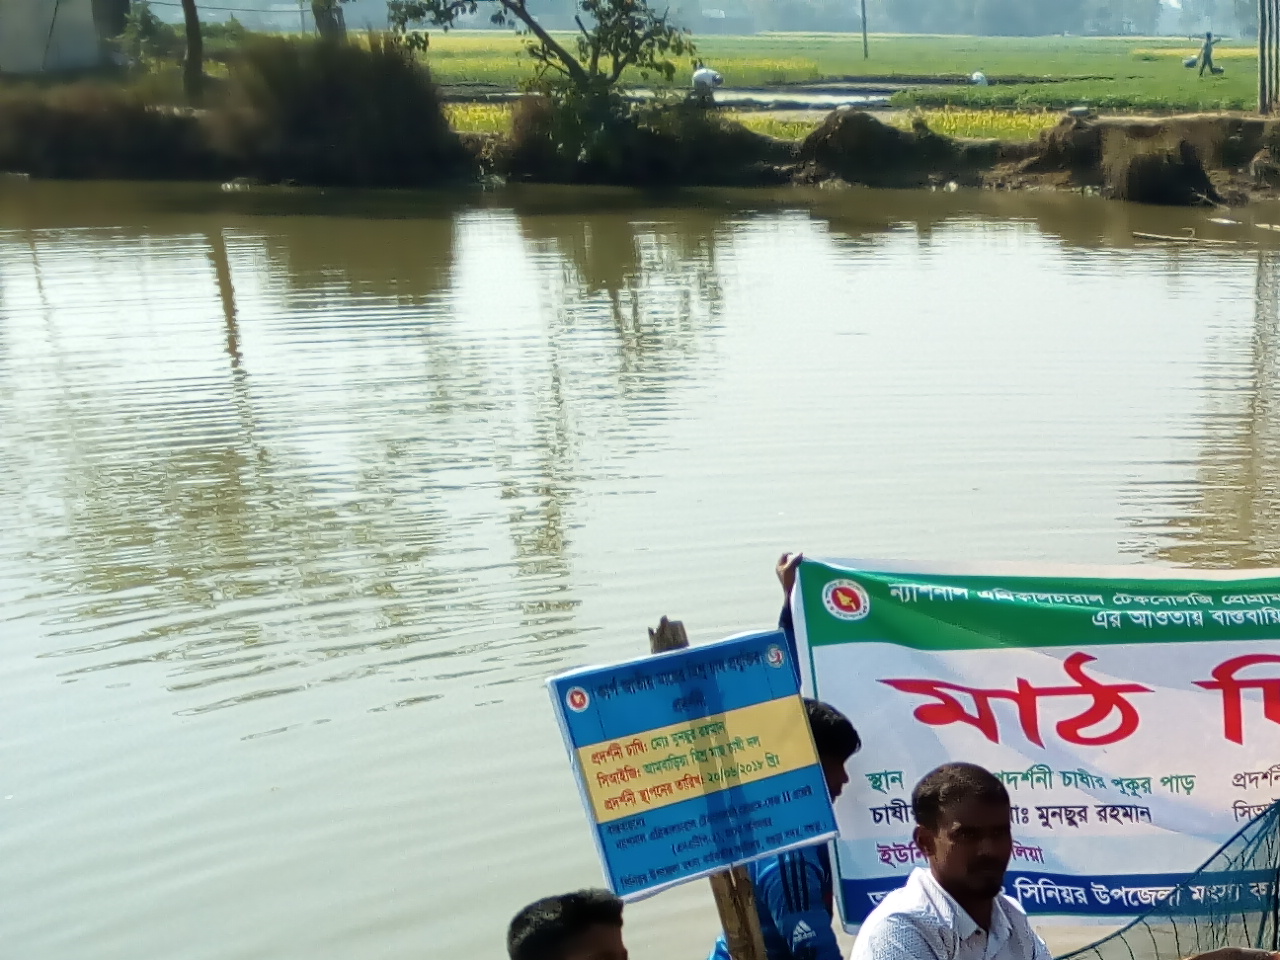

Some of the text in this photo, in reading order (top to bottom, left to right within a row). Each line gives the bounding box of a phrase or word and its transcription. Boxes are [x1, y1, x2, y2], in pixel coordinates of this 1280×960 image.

[1092, 609, 1121, 630] এর
[1127, 608, 1205, 628] আওতায়
[877, 651, 1157, 749] মাঠ
[865, 770, 904, 794] স্থান
[1058, 768, 1106, 790] চাষীর
[1111, 776, 1153, 798] পুকুর
[1160, 774, 1197, 796] পাড়
[869, 798, 914, 825] চাষী
[1035, 804, 1088, 830] মুনছুর
[1095, 804, 1152, 825] রহমান
[1013, 876, 1089, 907] সিনিয়র
